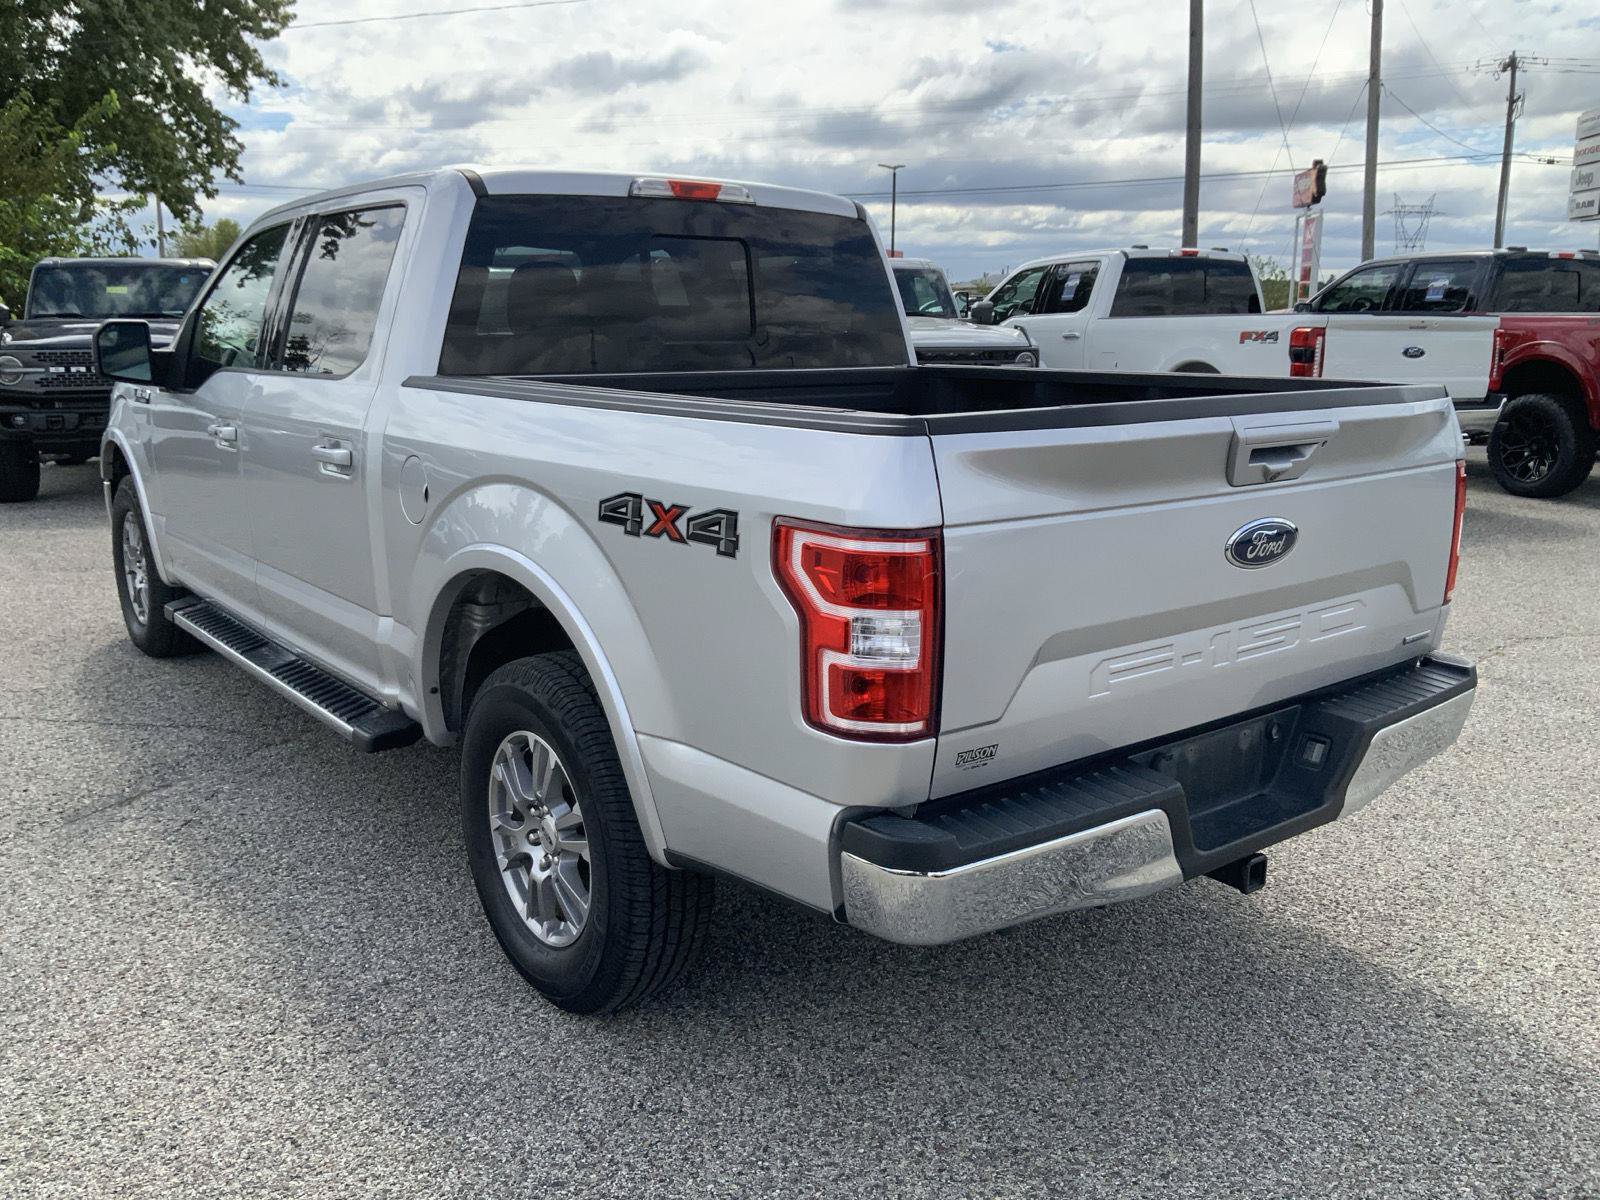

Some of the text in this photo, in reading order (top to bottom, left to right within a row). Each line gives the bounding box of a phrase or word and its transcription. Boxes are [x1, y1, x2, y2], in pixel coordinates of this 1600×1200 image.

[1576, 171, 1593, 187] Jeep
[1576, 200, 1595, 209] RAM
[1239, 331, 1279, 344] FX4
[1246, 529, 1287, 559] Ford
[1088, 599, 1366, 698] F-150
[955, 744, 998, 765] PILSON
